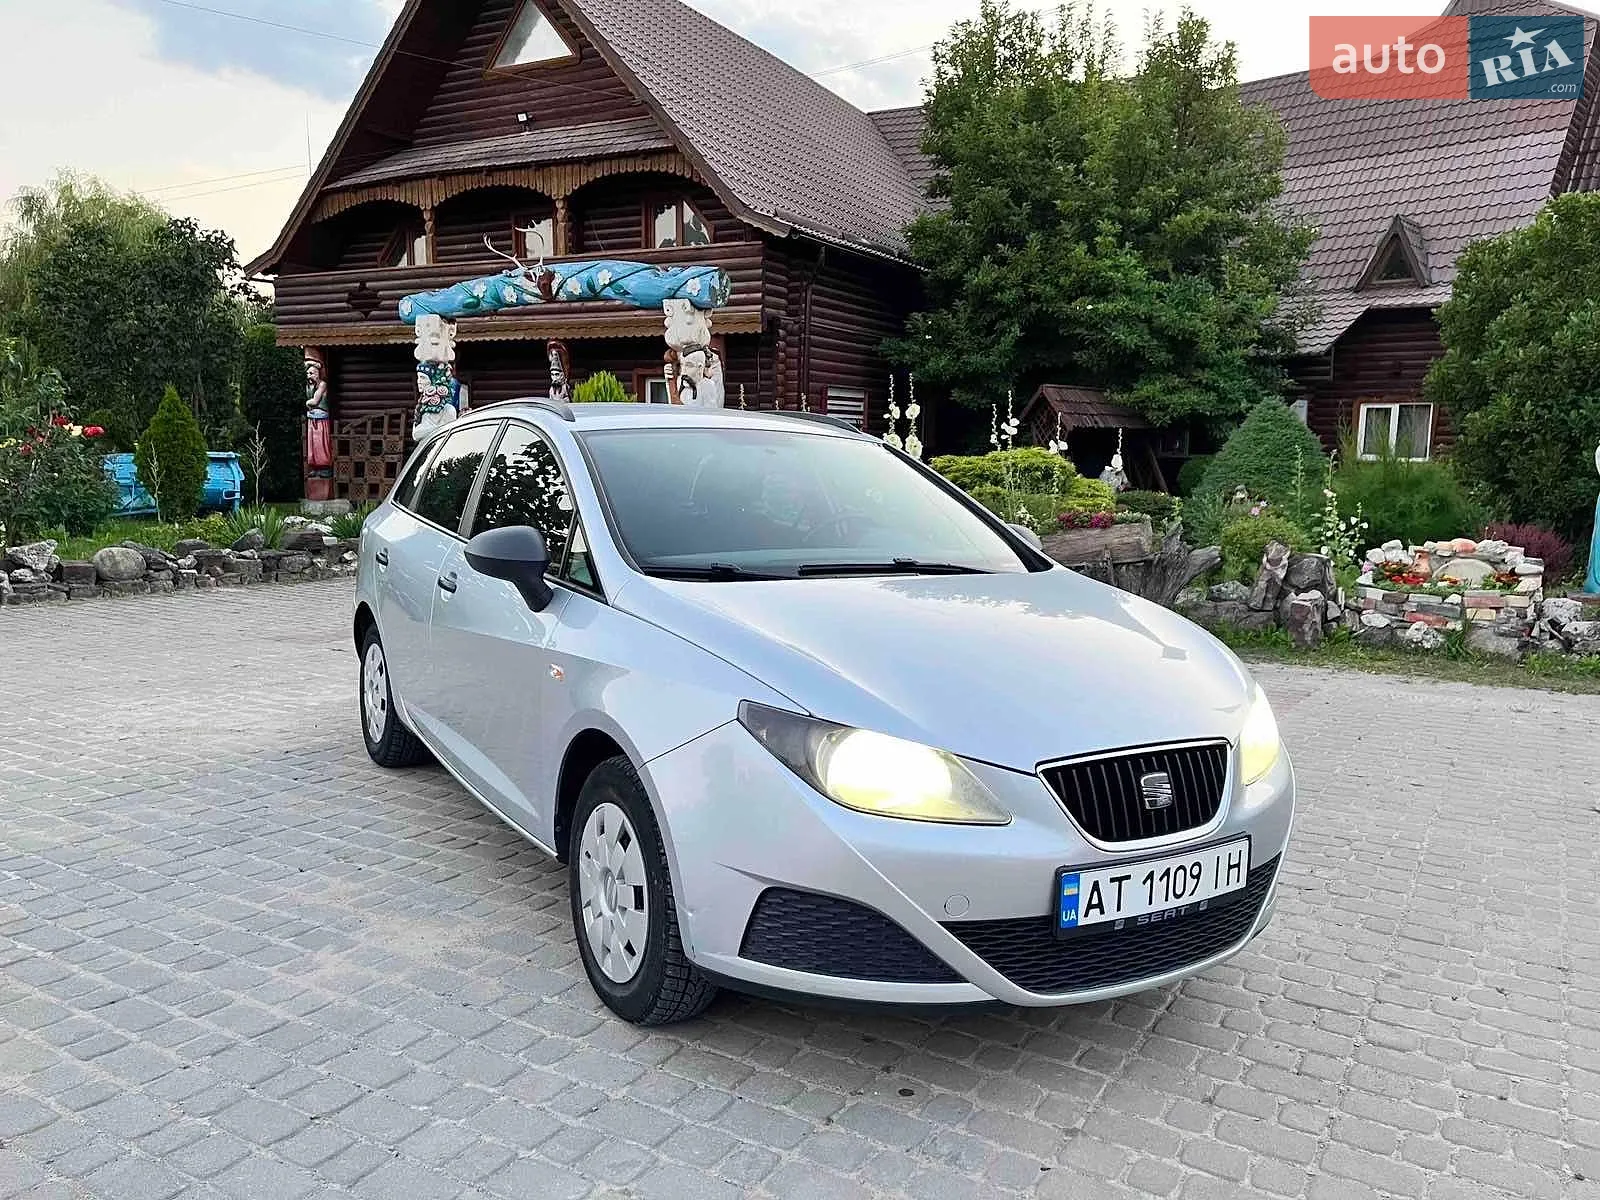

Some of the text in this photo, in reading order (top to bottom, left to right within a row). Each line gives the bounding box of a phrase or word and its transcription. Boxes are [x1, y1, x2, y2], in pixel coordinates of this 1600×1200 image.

[1083, 850, 1243, 918] AT 1109 IH
[1062, 910, 1077, 921] UA
[1137, 905, 1190, 925] SEAT
